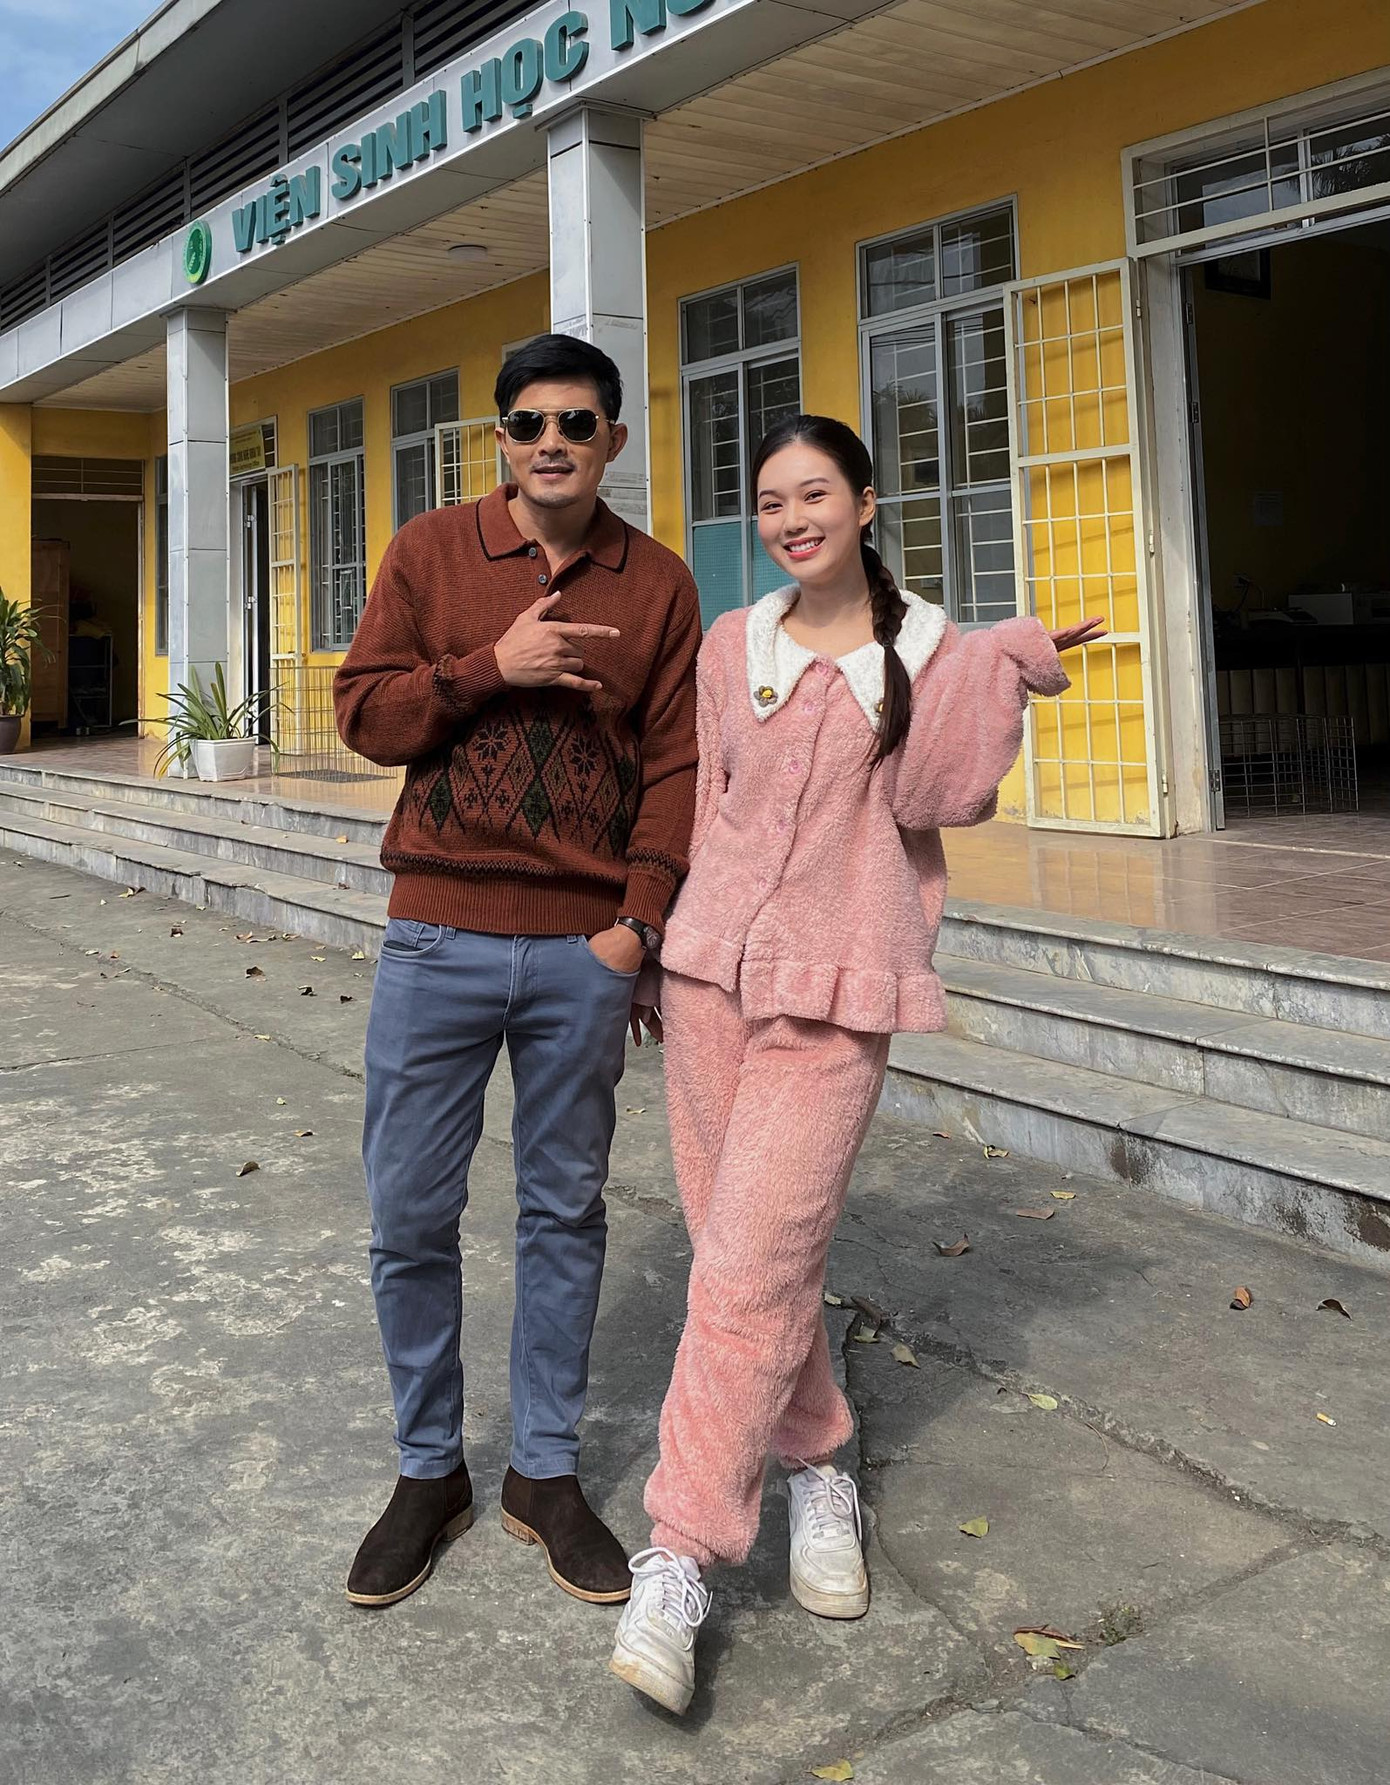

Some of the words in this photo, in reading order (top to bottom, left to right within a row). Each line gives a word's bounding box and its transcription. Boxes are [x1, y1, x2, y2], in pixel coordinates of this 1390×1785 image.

[232, 166, 320, 252] VIỆN
[331, 89, 447, 200] SINH
[460, 10, 589, 133] HỌC
